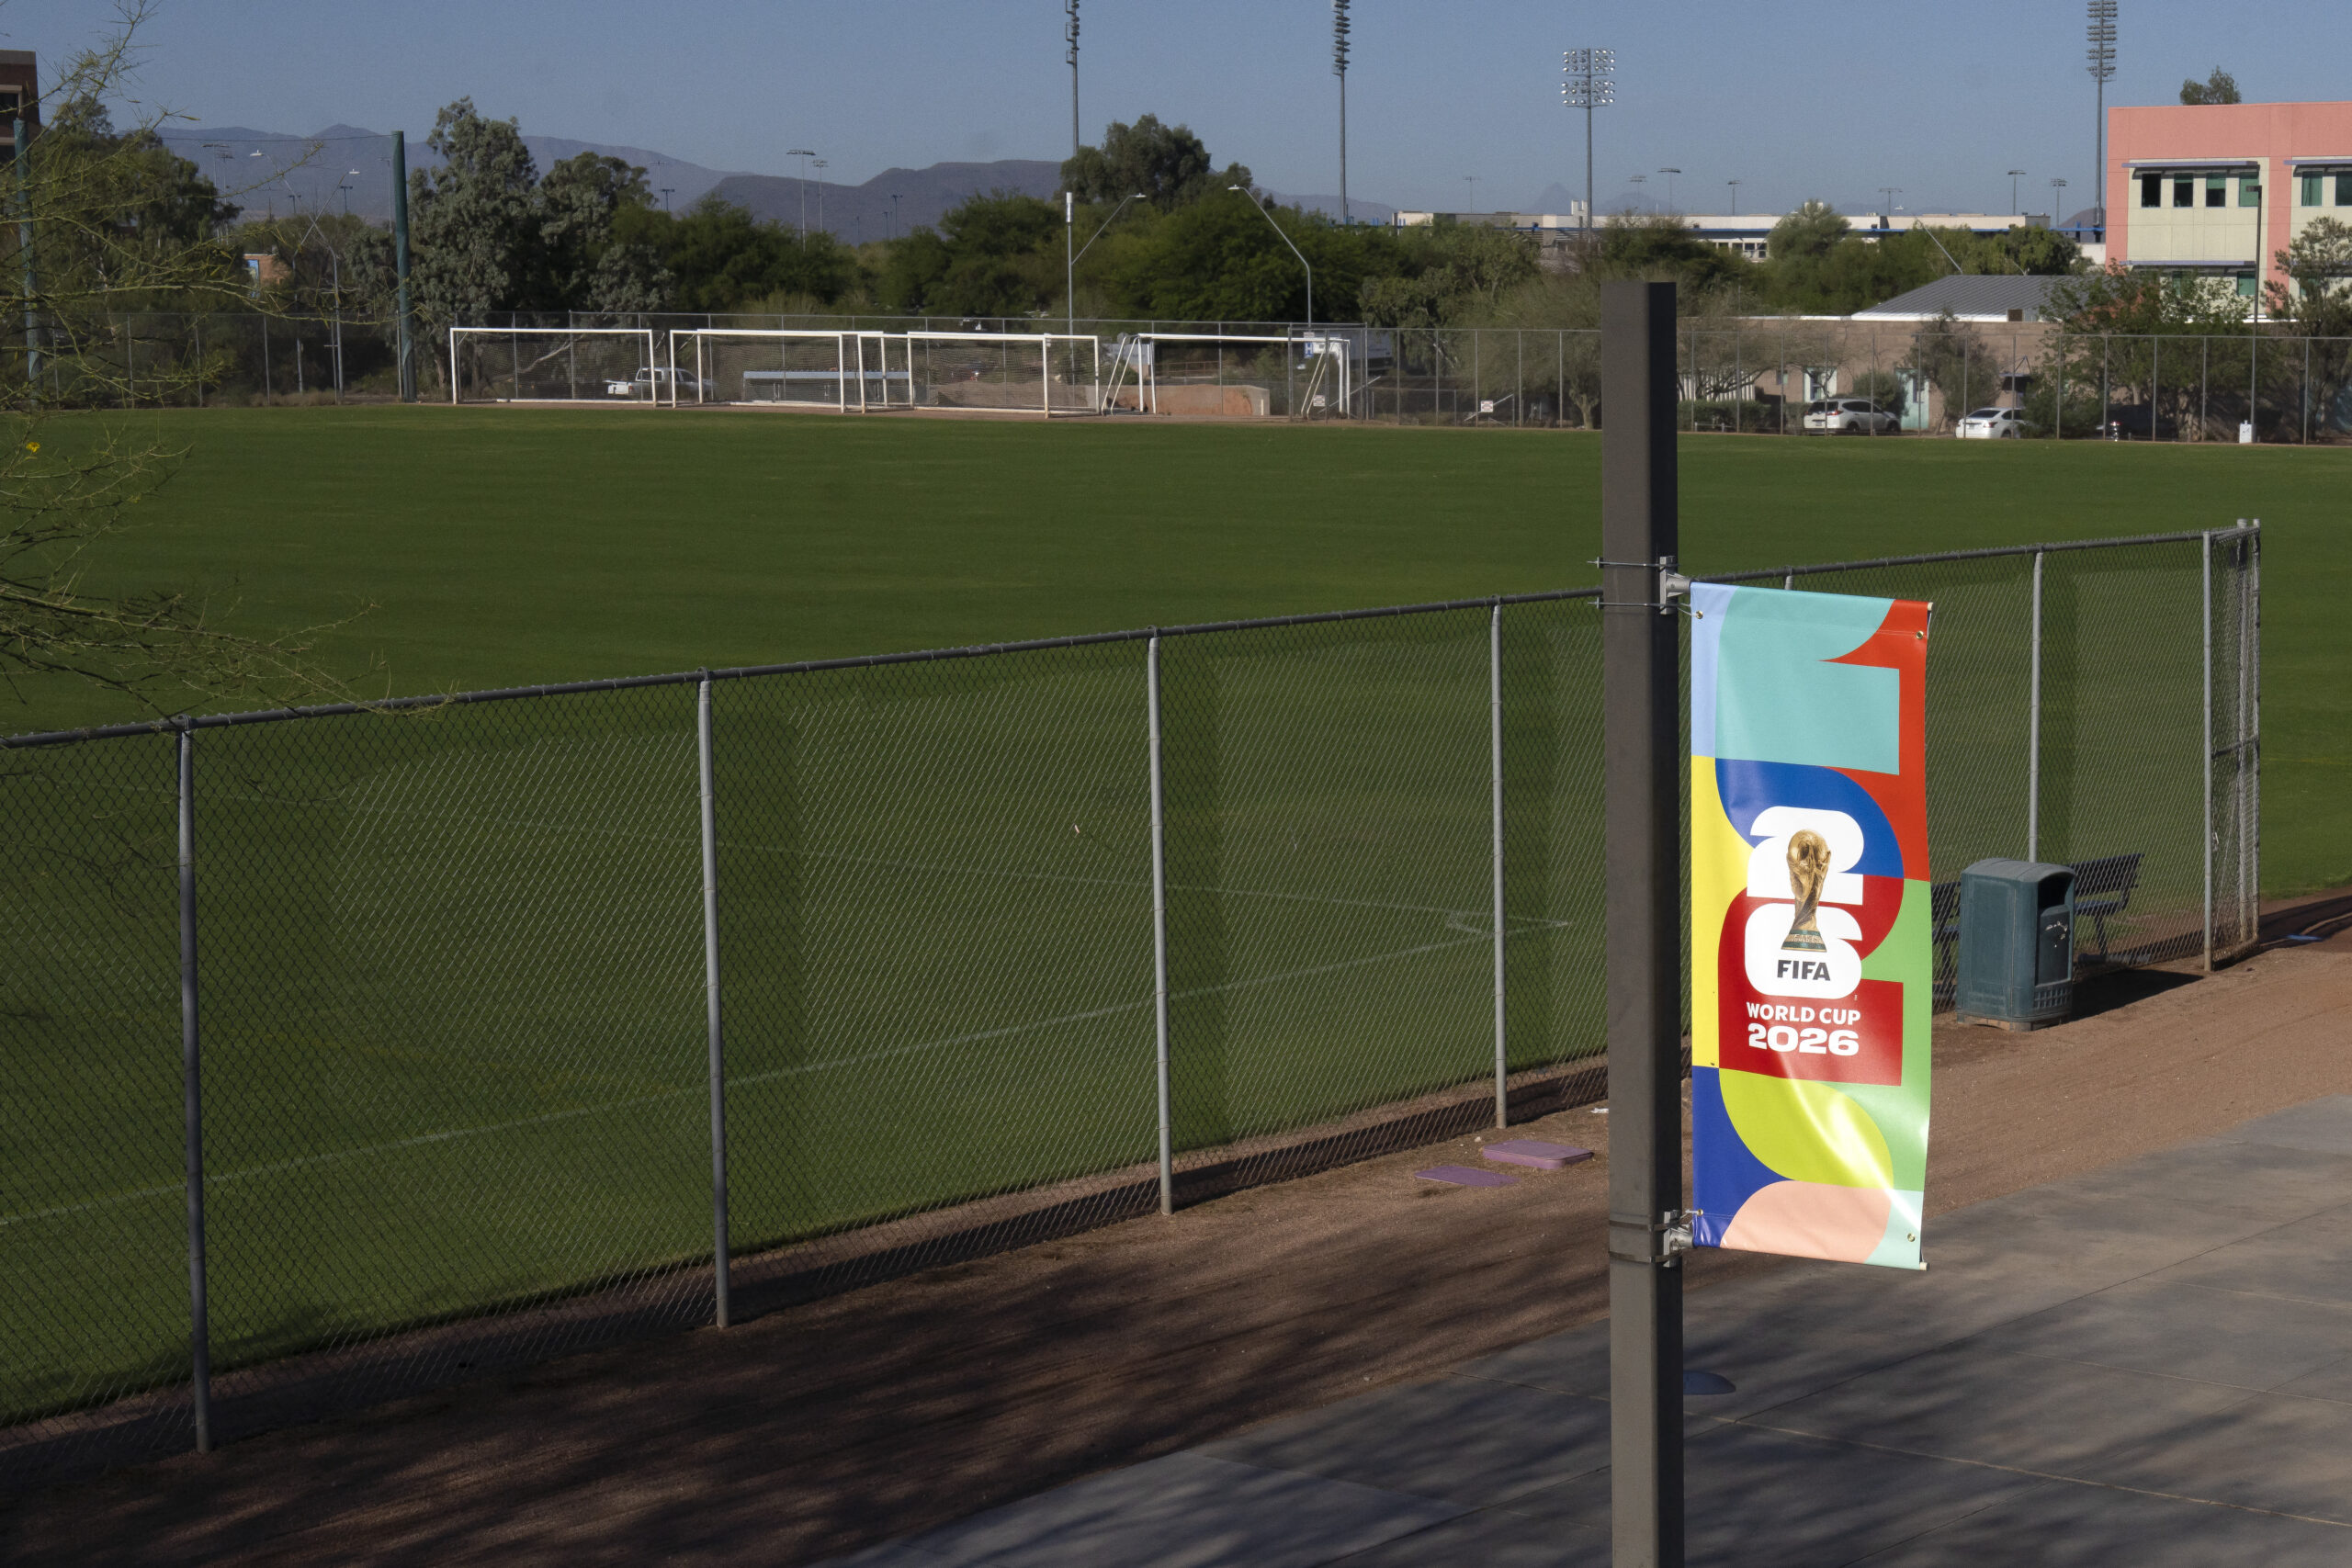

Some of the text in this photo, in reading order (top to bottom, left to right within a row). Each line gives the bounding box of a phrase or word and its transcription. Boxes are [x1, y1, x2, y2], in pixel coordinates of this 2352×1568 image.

[1777, 959, 1831, 981] FIFA
[1746, 1001, 1861, 1026] WORLD CUP
[1747, 1022, 1860, 1056] 2026
